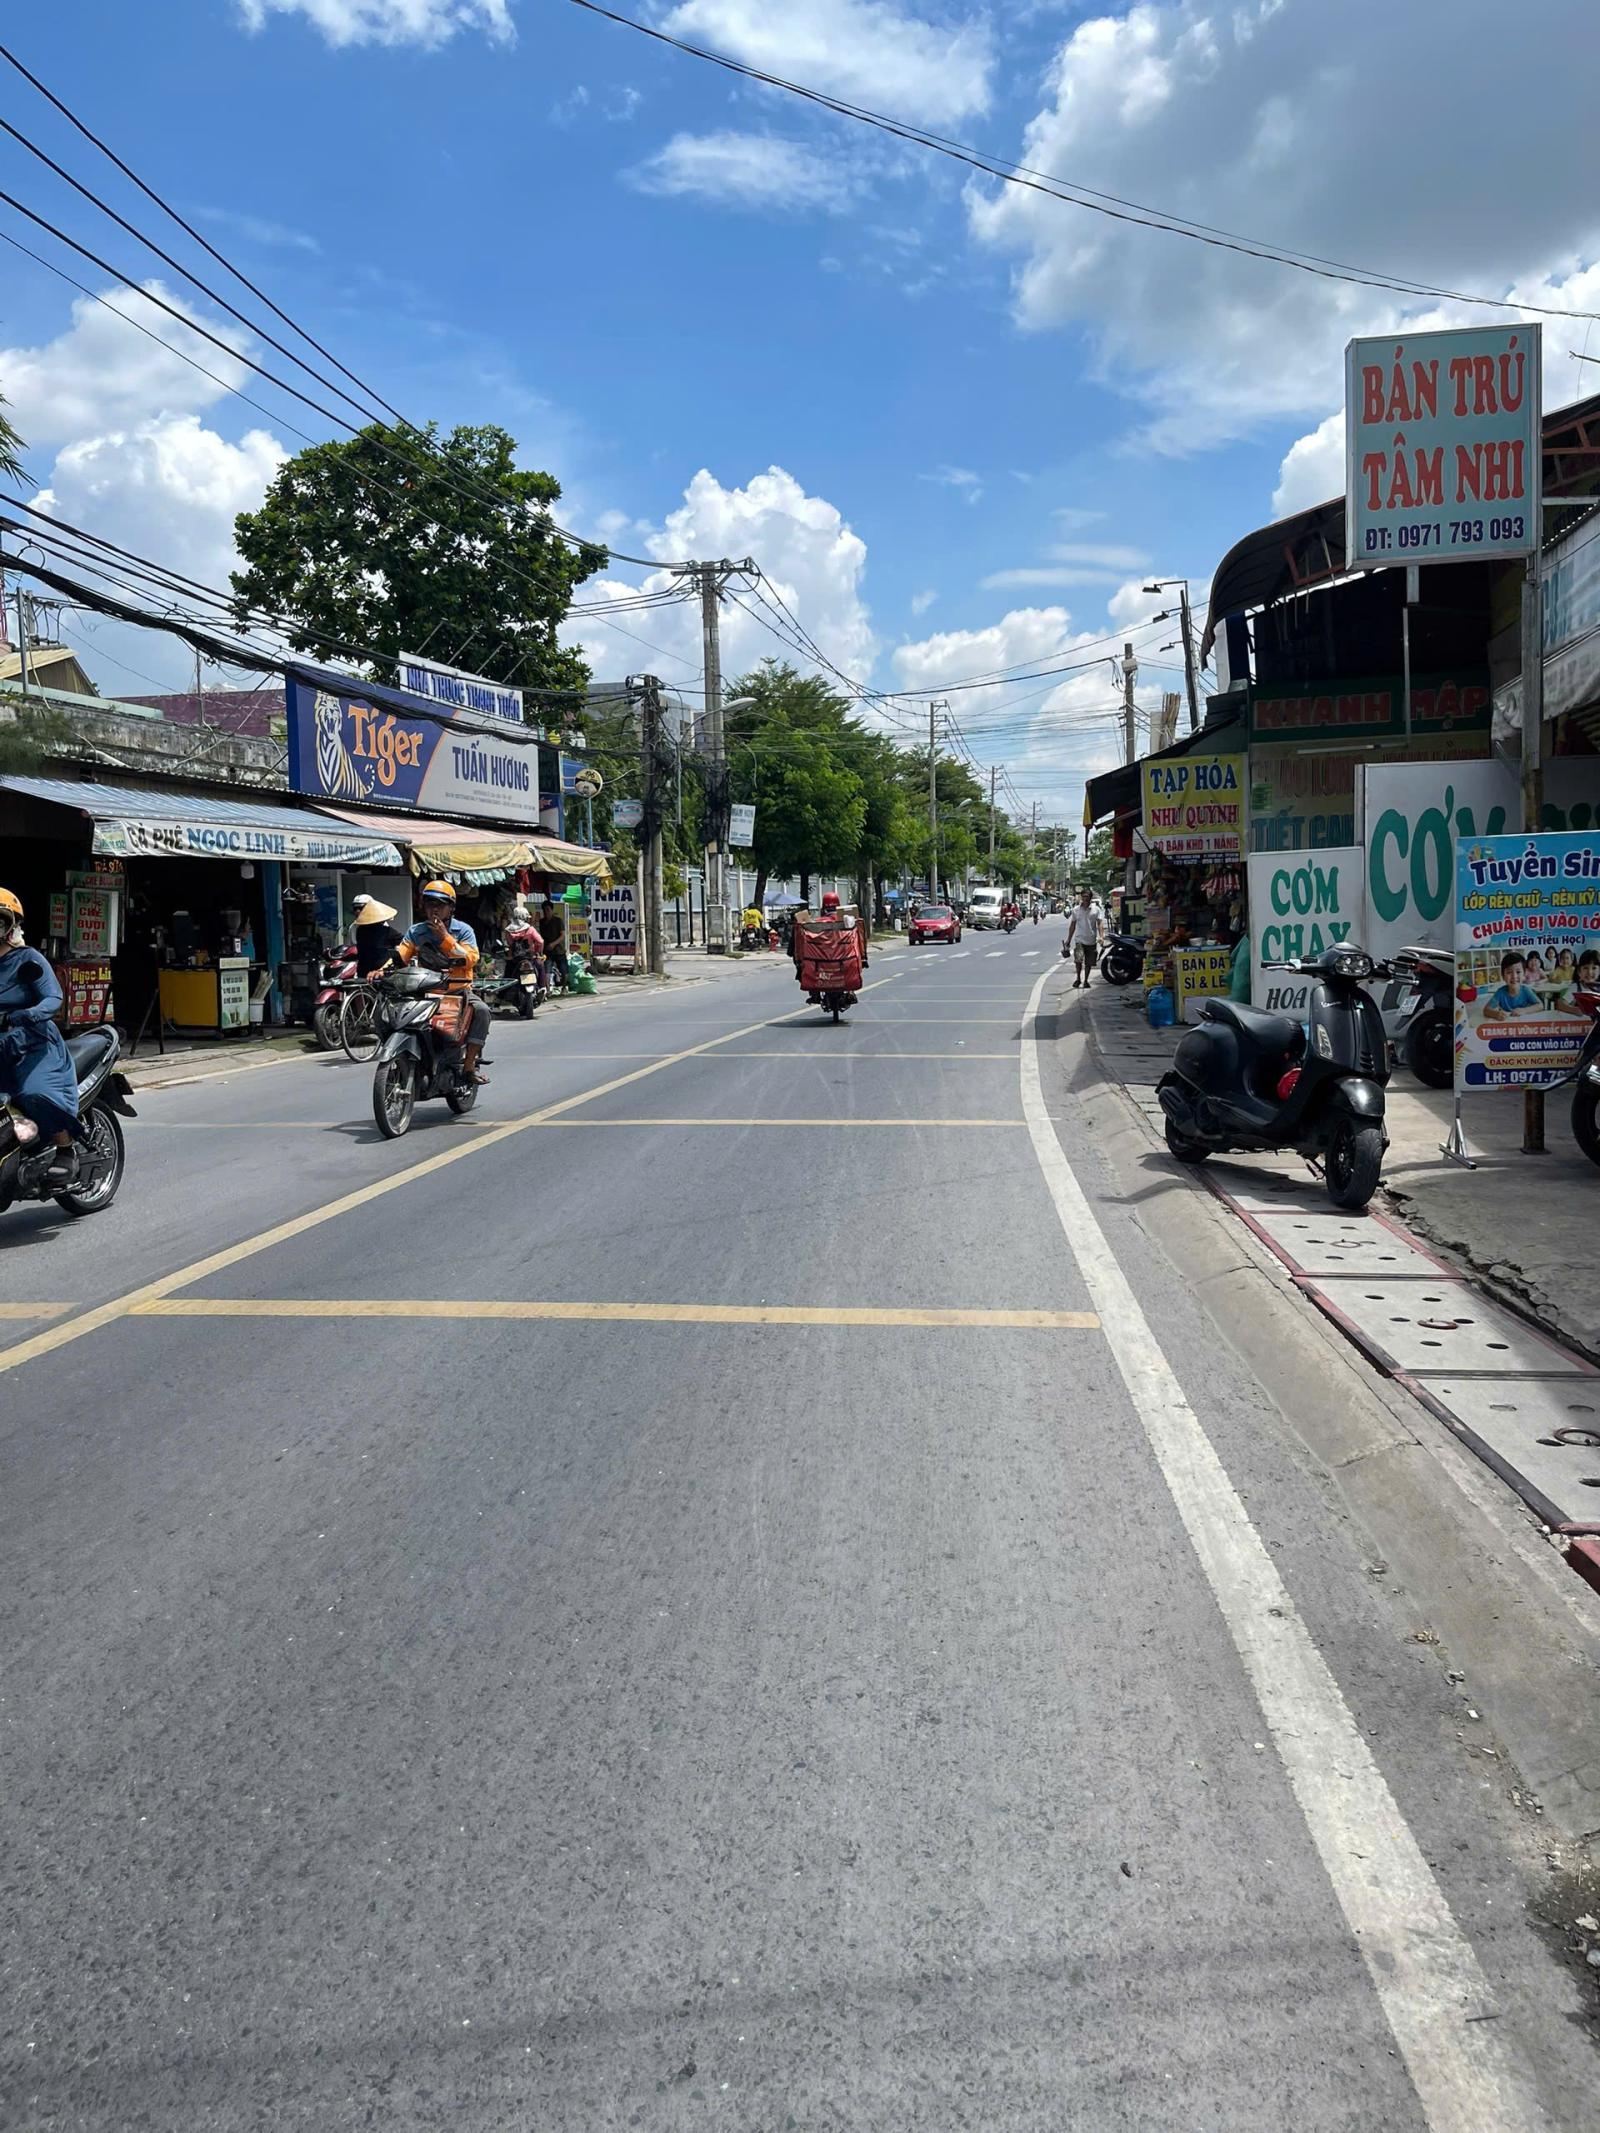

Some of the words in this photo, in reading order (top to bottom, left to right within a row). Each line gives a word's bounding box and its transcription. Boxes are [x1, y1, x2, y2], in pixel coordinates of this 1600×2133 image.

[1362, 345, 1439, 424] BÁN
[1450, 335, 1525, 417] TRÚ
[1362, 431, 1444, 511] TÂM
[1455, 440, 1525, 503] NHI
[1365, 527, 1392, 550] ĐT:
[1398, 523, 1440, 547] 0971
[1449, 519, 1483, 543] 793
[1489, 516, 1524, 541] 093
[347, 704, 423, 787] Tiger
[452, 741, 488, 785] TUẤN
[491, 754, 529, 792] HƯƠNG
[1150, 767, 1189, 799] TẠP
[1194, 757, 1238, 791] HÓA
[1151, 803, 1185, 827] NHƯ
[1187, 800, 1239, 829] QUỲNH
[153, 824, 183, 850] PHÊ
[186, 828, 240, 856] NGỌC
[244, 831, 286, 855] LINH
[1370, 785, 1505, 921] CƠ
[1470, 843, 1556, 885] Tuyển
[1270, 858, 1340, 917] CƠM
[1464, 890, 1486, 909] LỚP
[1489, 889, 1513, 908] RÈN
[1516, 889, 1541, 907] CHỮ
[1552, 888, 1576, 906] RÈN
[593, 904, 636, 923] THUỐC
[1472, 912, 1524, 939] CHUẨN
[1528, 916, 1543, 931] BỊ
[1547, 911, 1578, 928] VÀO
[596, 925, 633, 940] TÂY
[1508, 932, 1535, 946] (Tiền
[1561, 934, 1585, 946] Học)
[1199, 976, 1208, 989] &
[1266, 986, 1307, 1010] HOA
[1510, 1041, 1525, 1050] CHO
[1526, 1041, 1542, 1050] CON
[1485, 1071, 1506, 1083] LH:
